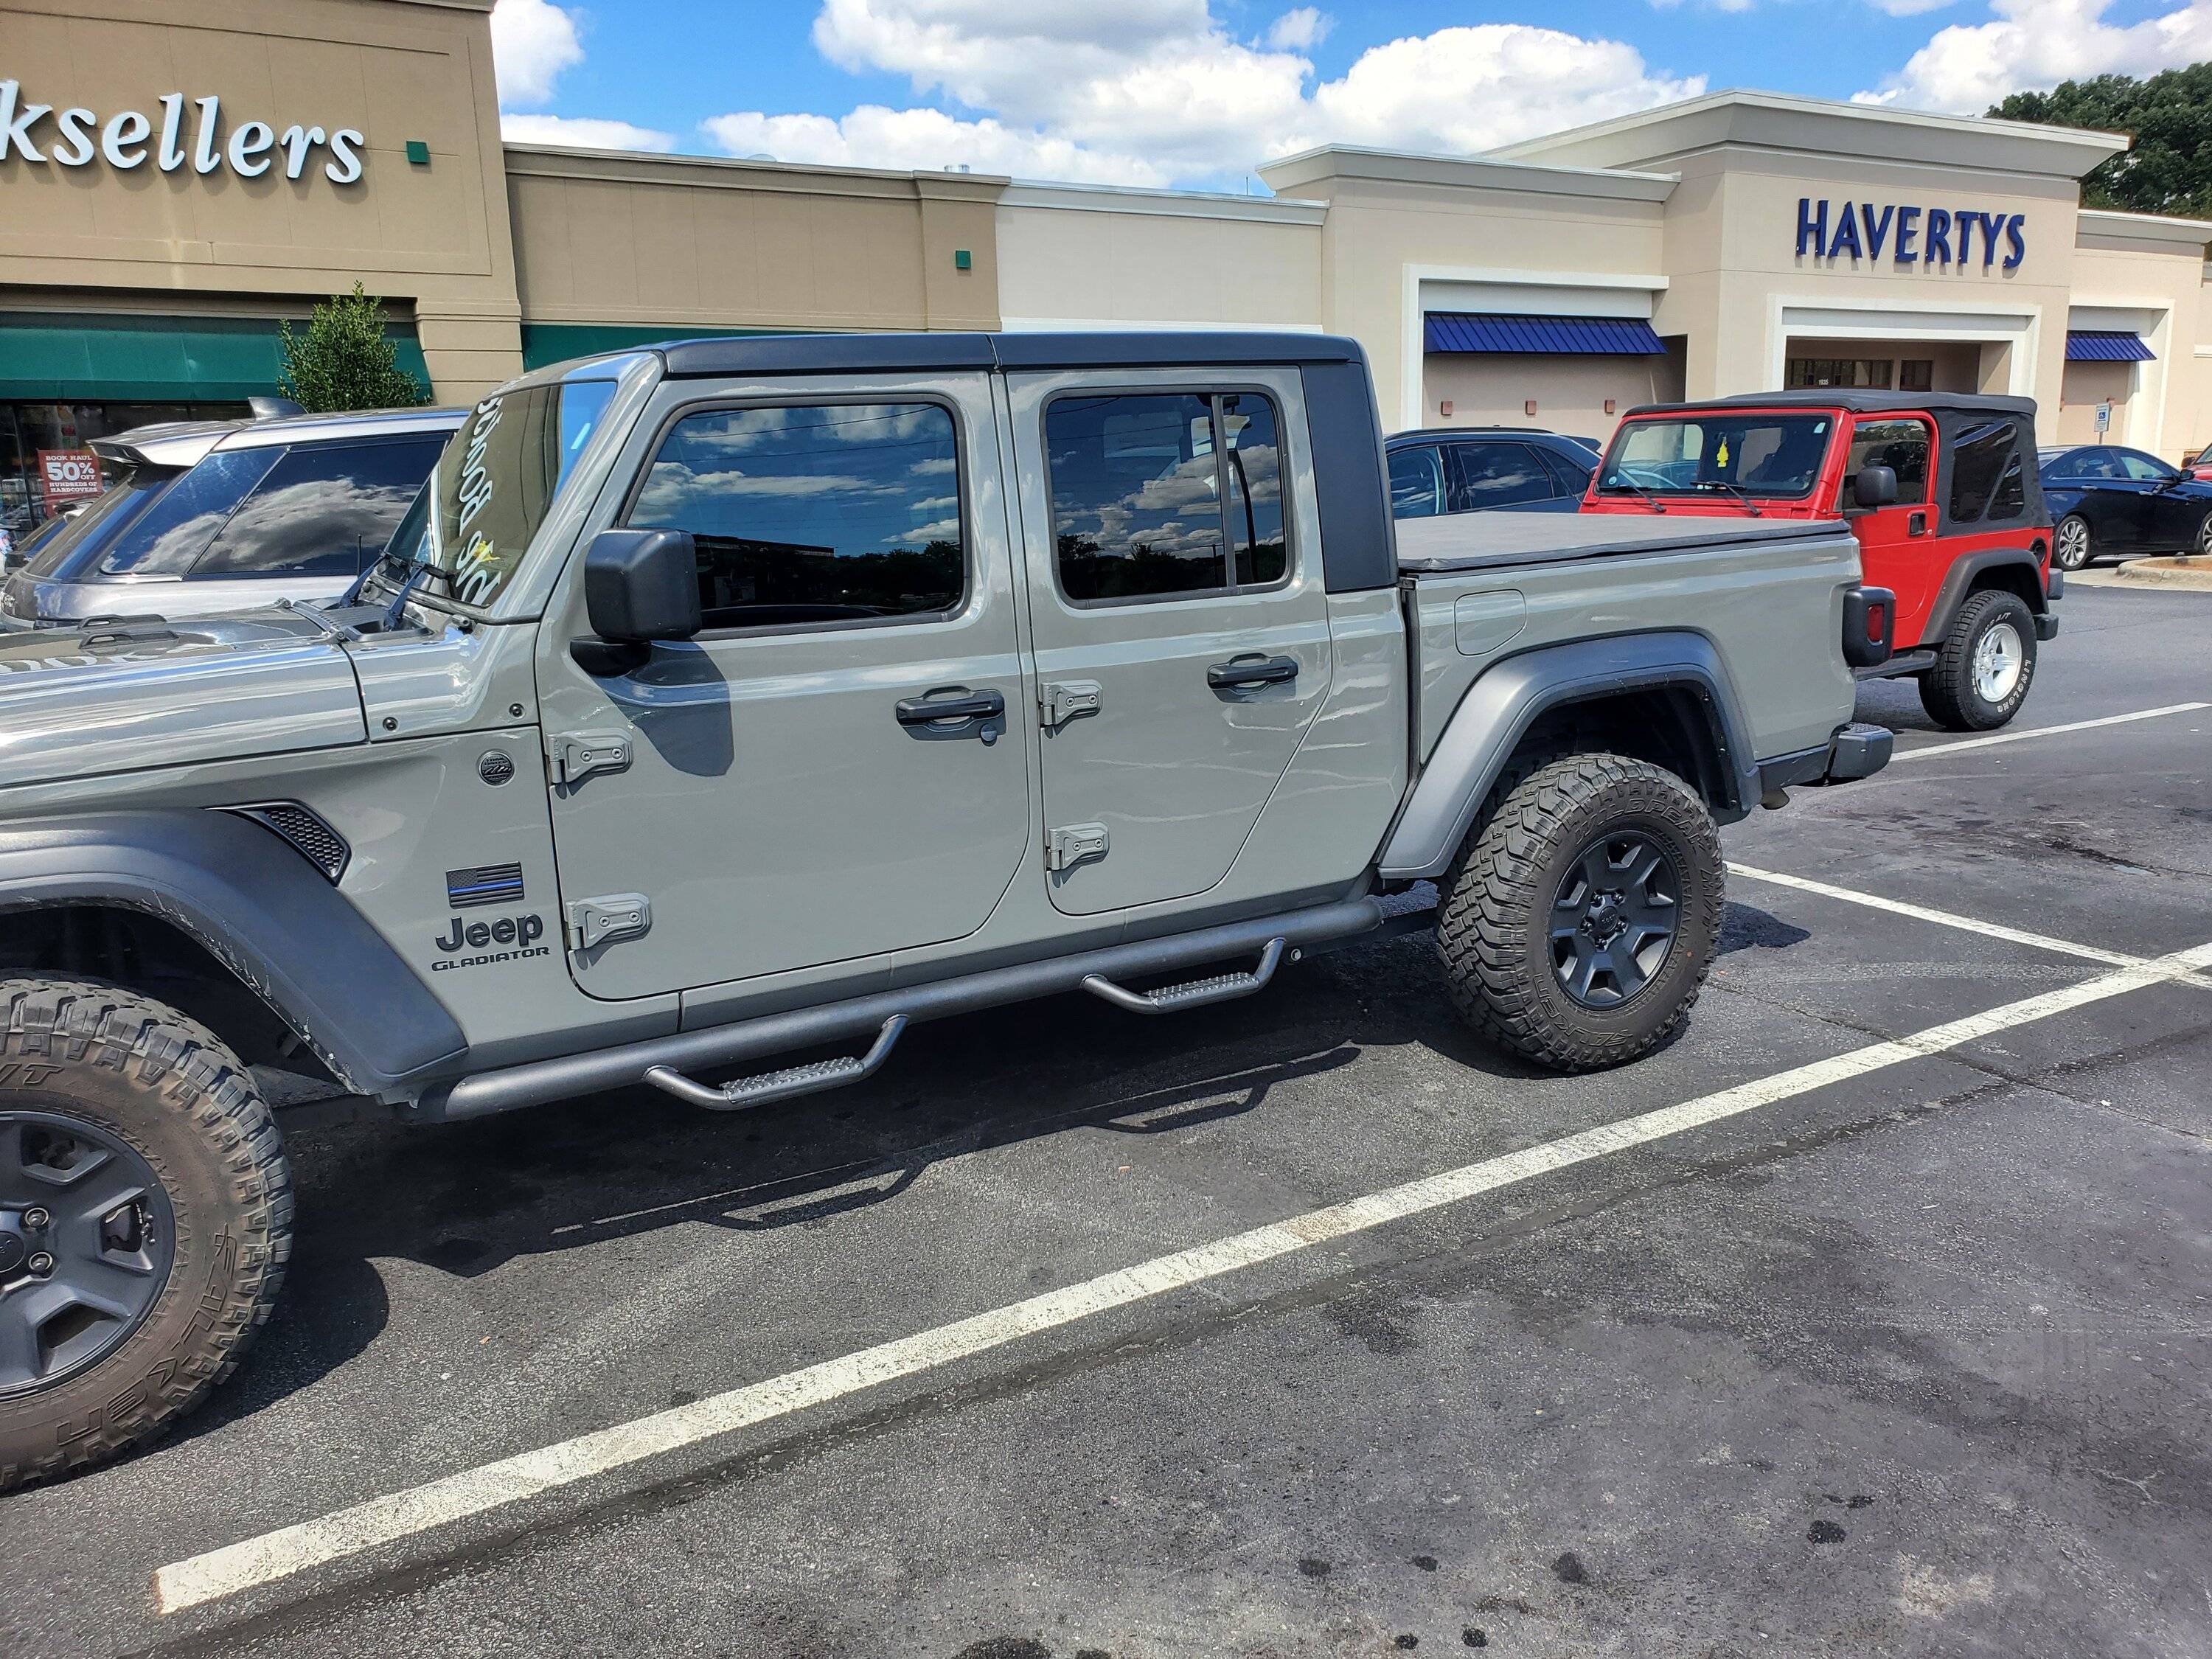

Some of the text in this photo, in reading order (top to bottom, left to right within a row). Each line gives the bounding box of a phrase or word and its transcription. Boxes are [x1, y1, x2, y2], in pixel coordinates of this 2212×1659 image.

[0, 80, 364, 184] ksellers
[1796, 198, 2025, 269] HAVERTYS
[46, 462, 95, 481] 50%
[431, 946, 551, 972] GLADIATOR
[435, 914, 543, 952] Jeep
[56, 1221, 237, 1447] FALKEN
